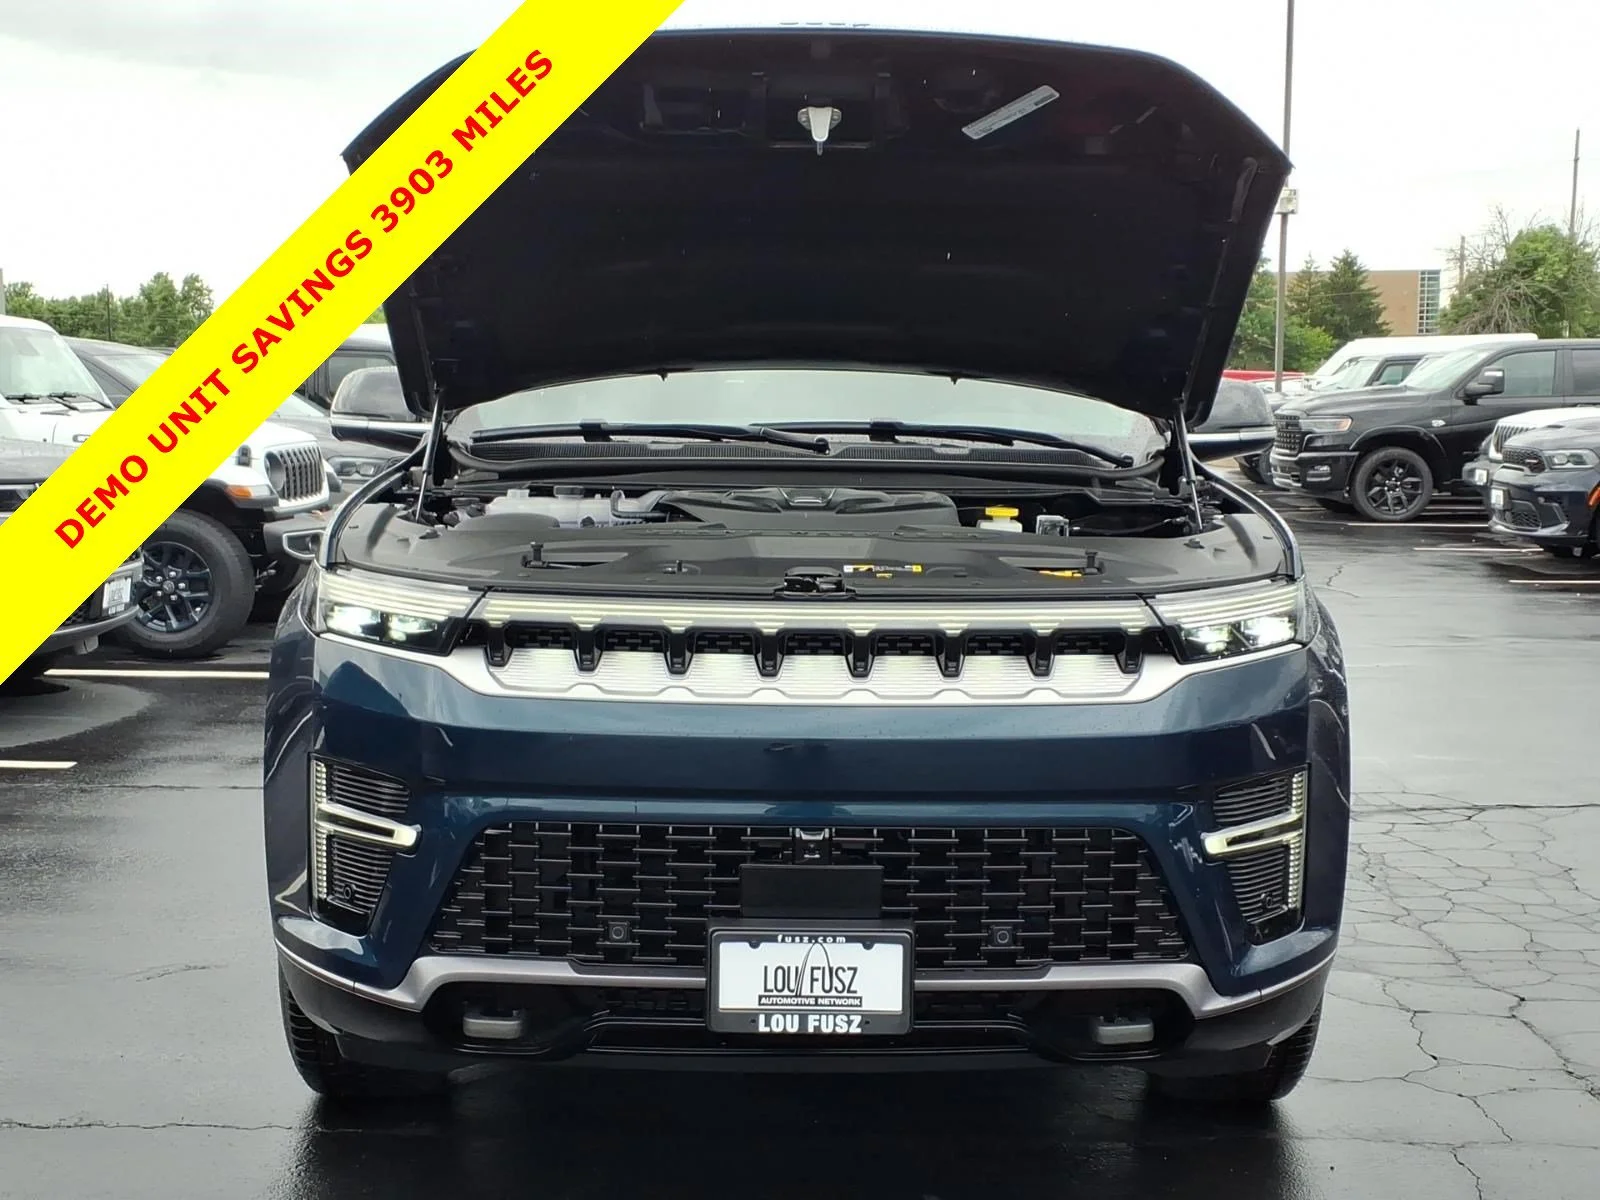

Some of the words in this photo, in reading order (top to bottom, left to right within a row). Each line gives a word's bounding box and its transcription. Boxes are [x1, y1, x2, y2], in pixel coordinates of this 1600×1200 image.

[777, 934, 846, 944] fusz.com
[763, 965, 799, 993] LOU
[810, 966, 857, 994] FUSZ
[759, 996, 815, 1006] AUTOMOTIVE
[817, 997, 861, 1007] NETWORK
[758, 1014, 799, 1032] LOU
[807, 1014, 862, 1032] FUSZ
